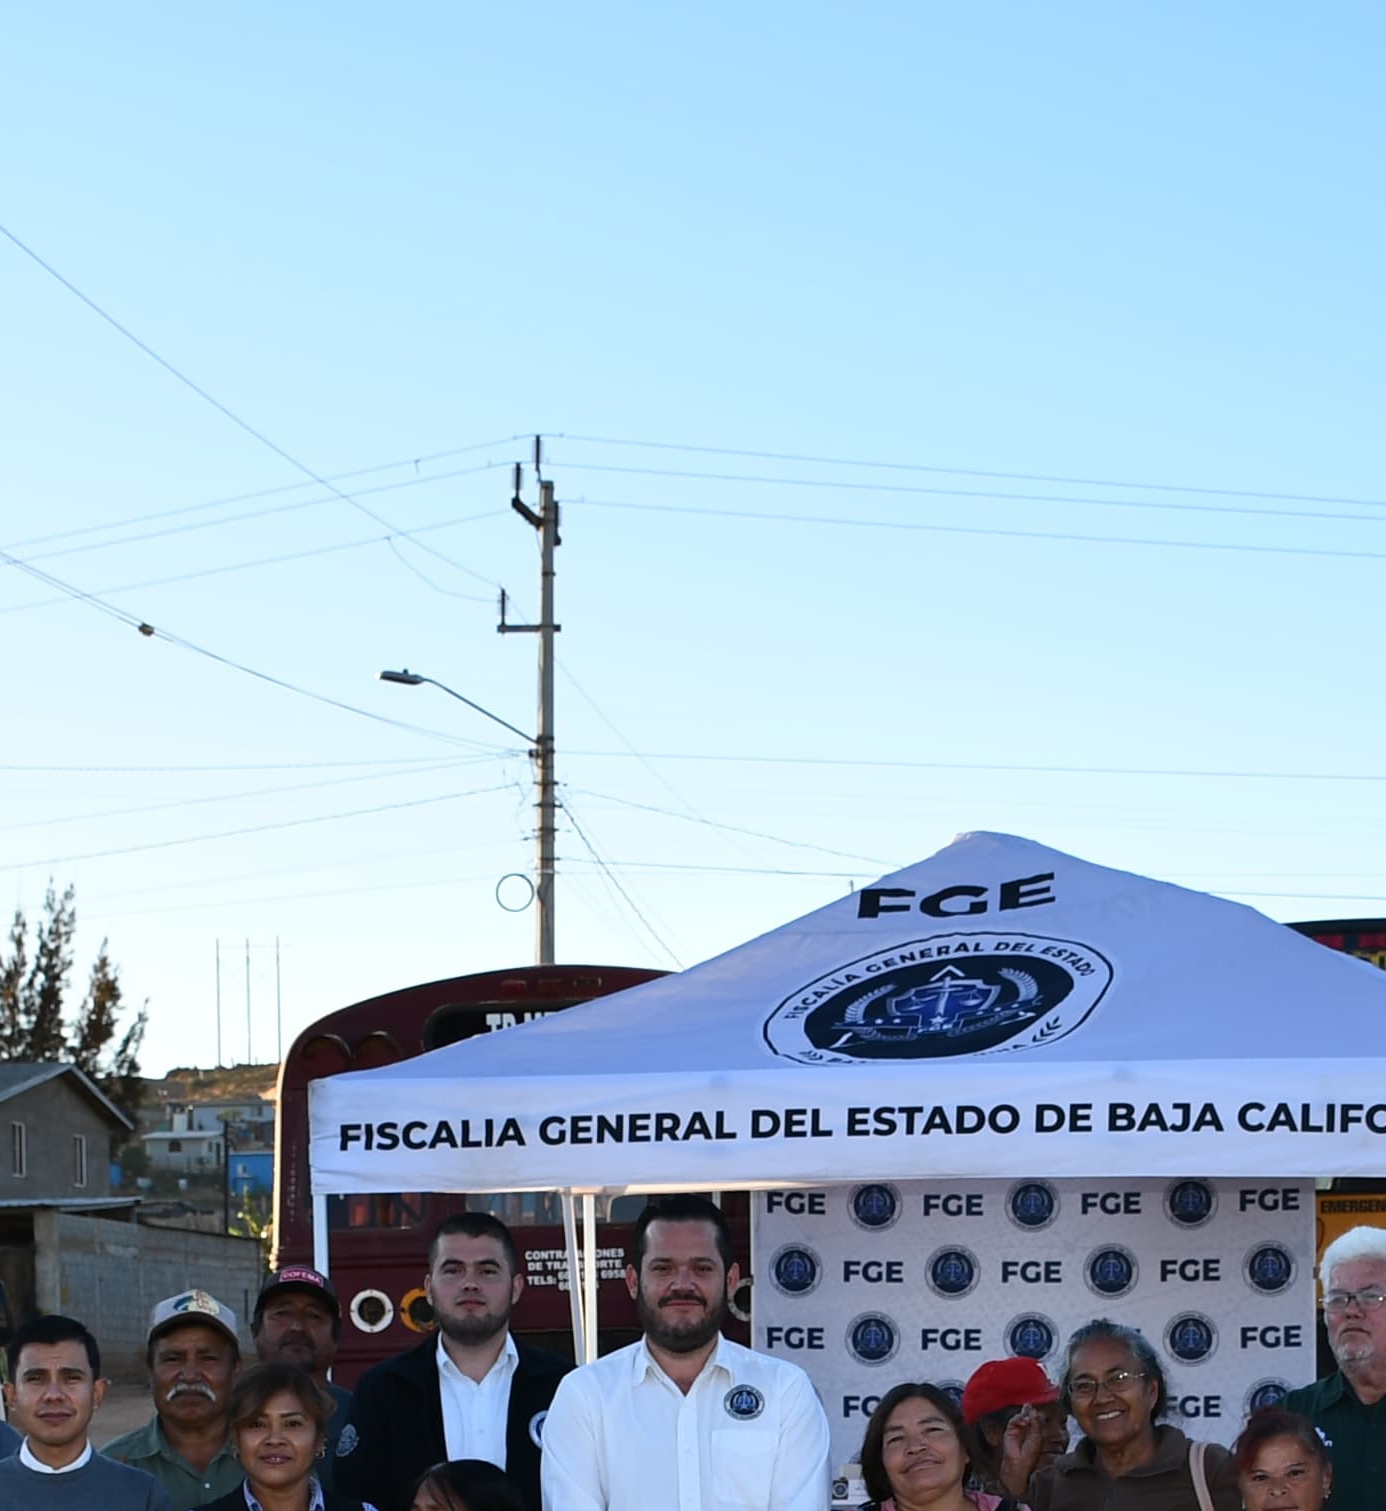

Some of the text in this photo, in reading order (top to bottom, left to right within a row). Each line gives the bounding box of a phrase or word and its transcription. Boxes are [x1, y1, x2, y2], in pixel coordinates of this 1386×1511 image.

[857, 872, 1056, 919] FGE
[865, 942, 985, 974] GENERAL
[992, 941, 1035, 954] DEL
[1035, 943, 1097, 977] ESTADO
[339, 1117, 526, 1151] FISCALIA
[539, 1110, 736, 1146] GENERAL
[751, 1108, 833, 1139] DEL
[847, 1104, 1019, 1137] ESTADO
[1035, 1103, 1093, 1133] DE
[1108, 1102, 1224, 1133] BAJA
[767, 1191, 826, 1215] FGE
[923, 1193, 984, 1216] FGE
[1081, 1191, 1142, 1215] FGE
[1239, 1188, 1301, 1212] FGE
[528, 1262, 544, 1271] DE
[843, 1260, 904, 1283] FGE
[1001, 1260, 1062, 1284] FGE
[1160, 1258, 1221, 1283] FGE
[766, 1326, 825, 1350] FGE
[921, 1328, 982, 1351] FGE
[1240, 1325, 1302, 1349] FGE
[843, 1395, 881, 1419] FG
